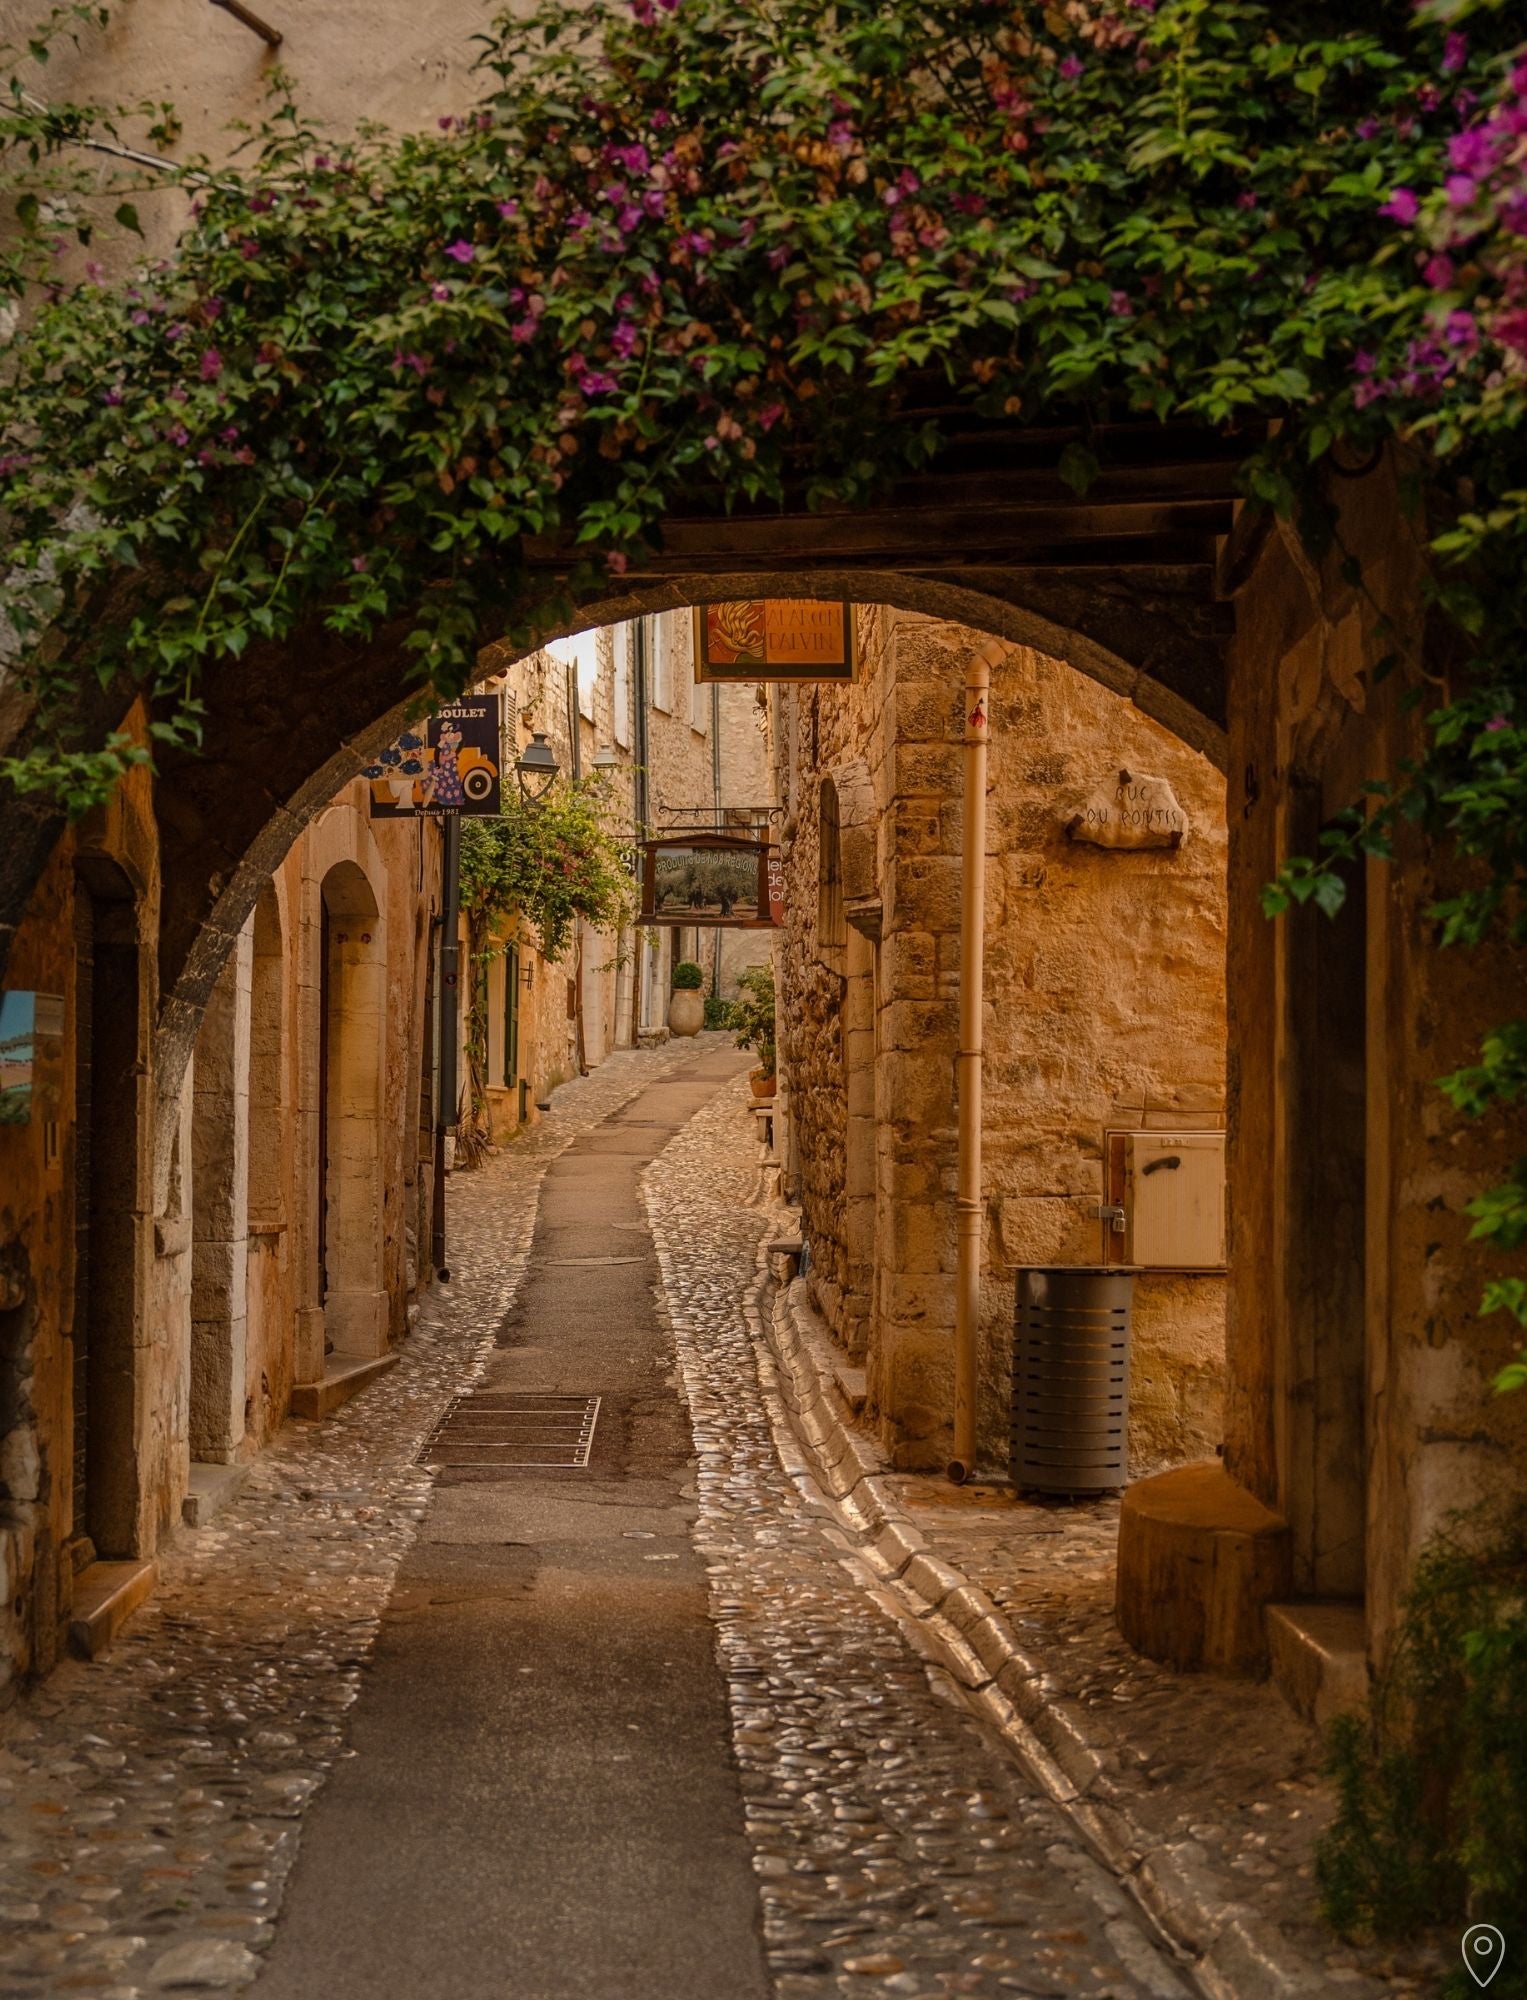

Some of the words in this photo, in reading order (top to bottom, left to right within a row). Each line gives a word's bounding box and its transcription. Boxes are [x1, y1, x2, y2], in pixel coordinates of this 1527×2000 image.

[1114, 785, 1147, 801] RUE
[414, 809, 441, 817] Depuis
[442, 808, 460, 816] 1981
[1086, 807, 1108, 825] DU
[1121, 808, 1177, 827] PONTIS
[656, 854, 694, 875] PRODUITS
[695, 854, 706, 865] DE
[707, 854, 724, 865] NOS
